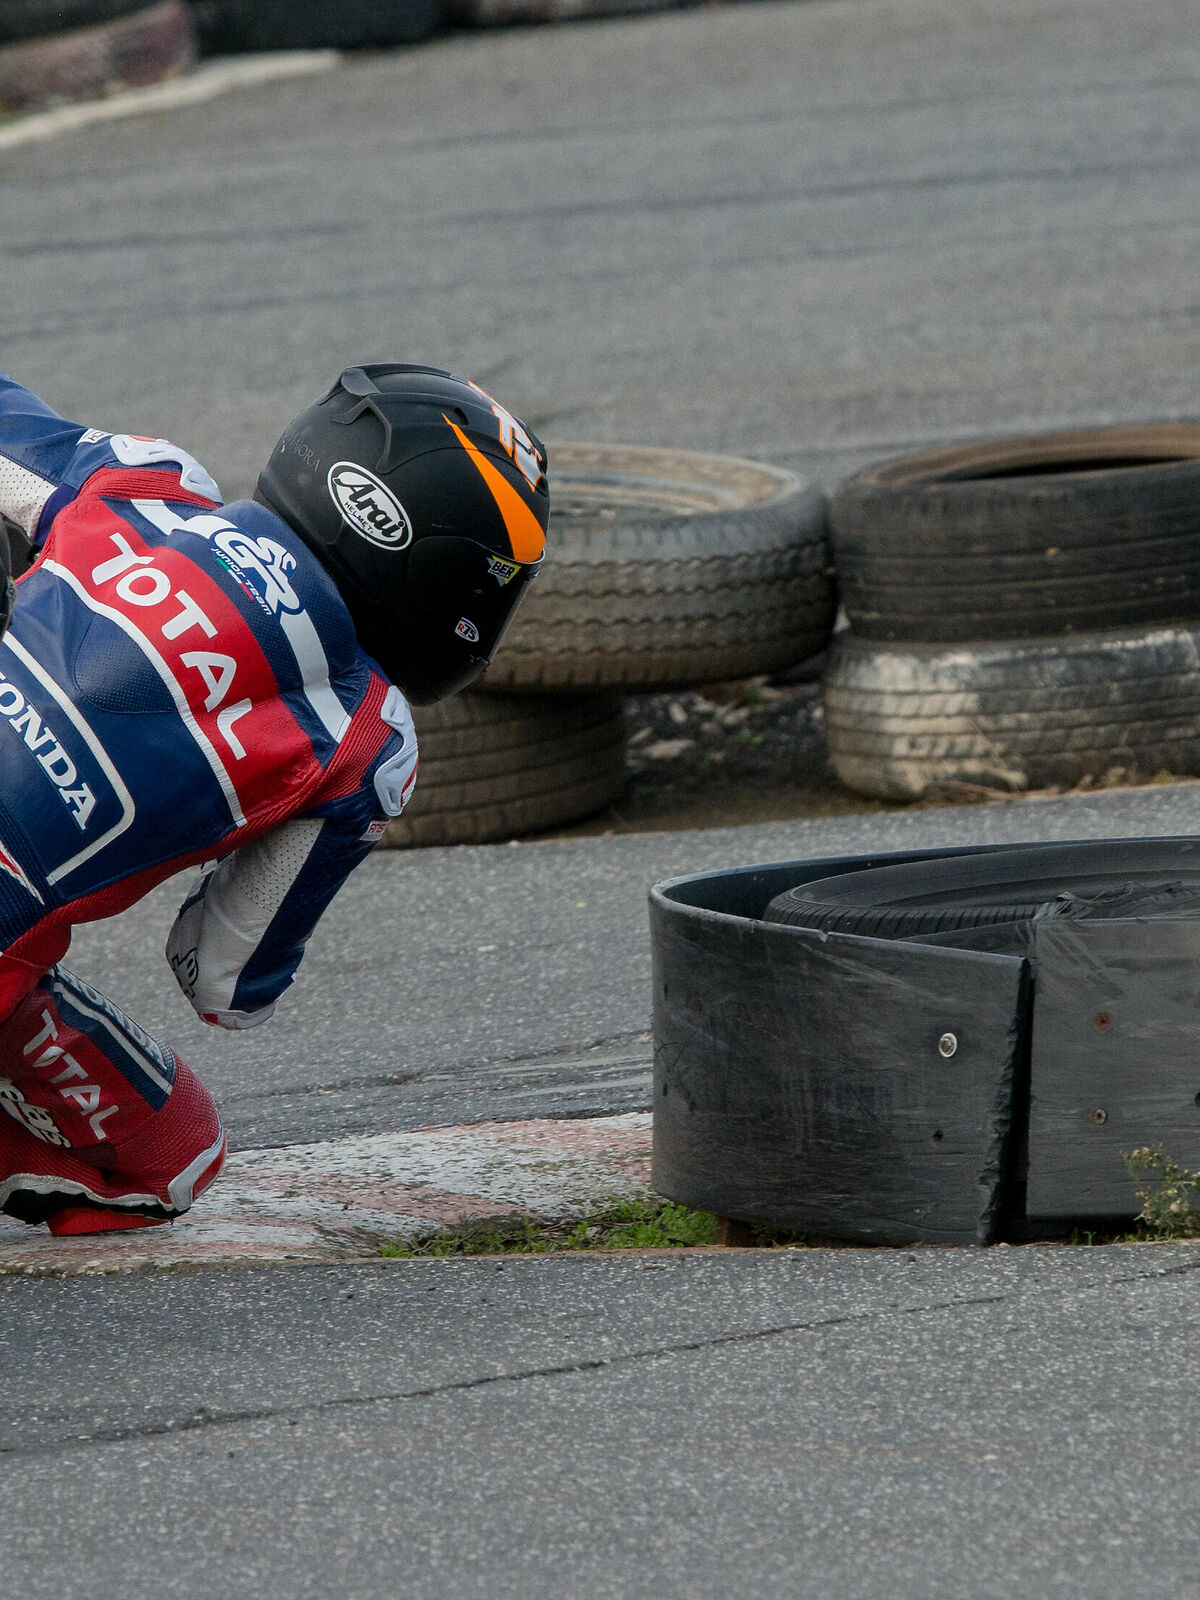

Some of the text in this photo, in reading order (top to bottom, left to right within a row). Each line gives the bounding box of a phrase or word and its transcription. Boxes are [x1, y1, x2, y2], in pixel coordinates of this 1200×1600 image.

[333, 478, 404, 537] Arai
[344, 502, 372, 531] HELMET
[92, 532, 253, 760] TOTAL
[23, 1008, 119, 1141] TOTAL
